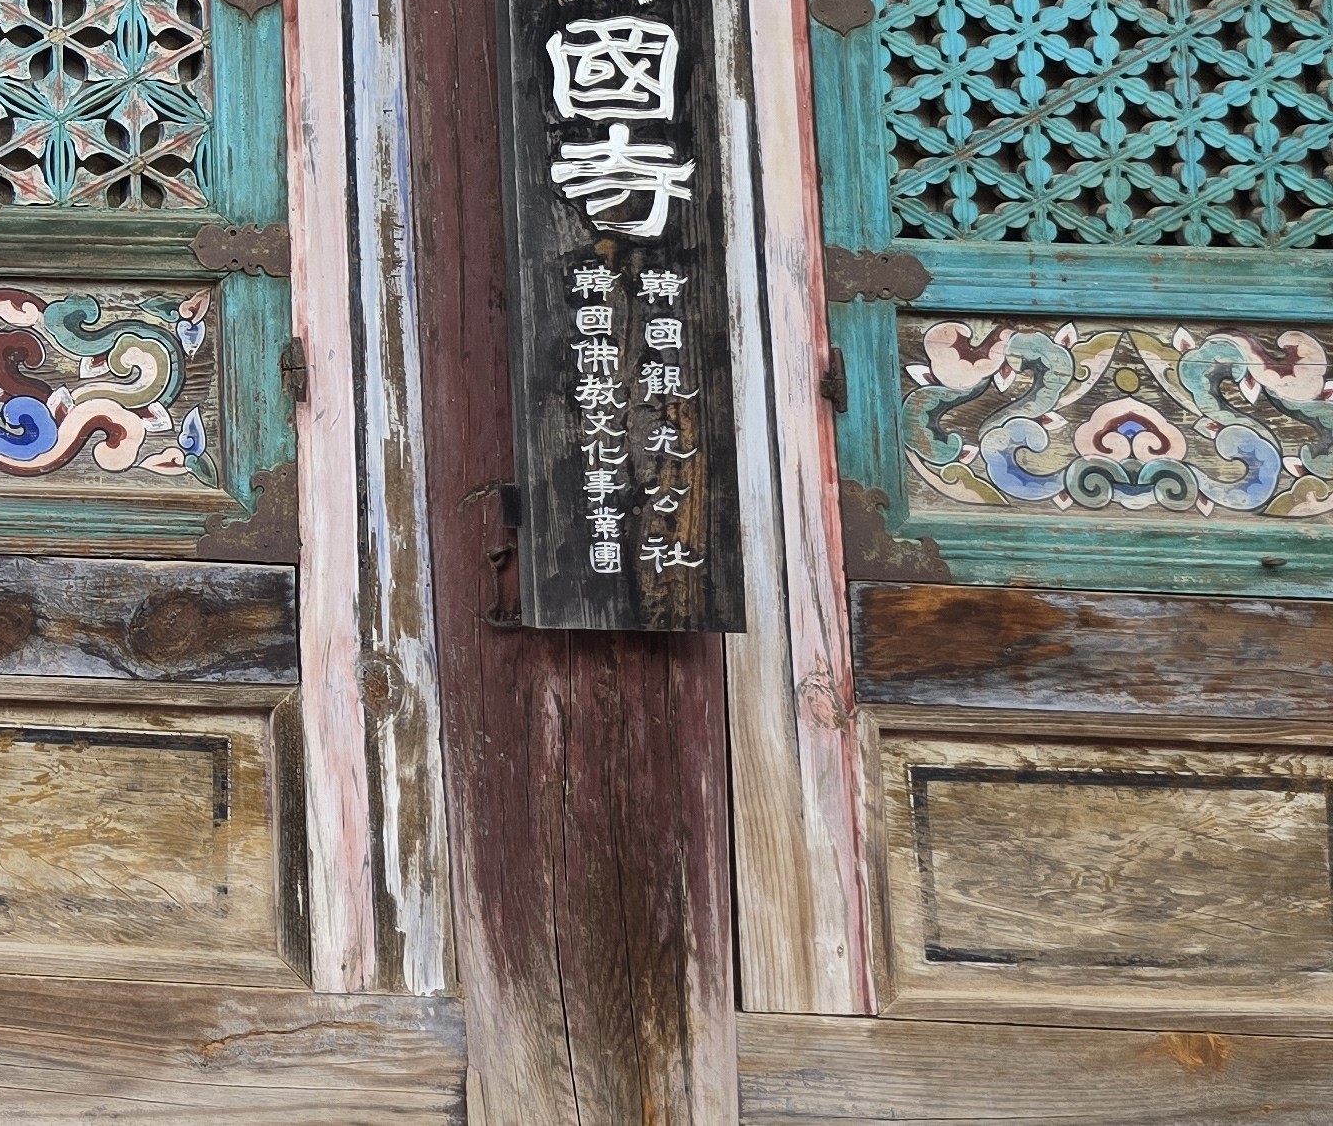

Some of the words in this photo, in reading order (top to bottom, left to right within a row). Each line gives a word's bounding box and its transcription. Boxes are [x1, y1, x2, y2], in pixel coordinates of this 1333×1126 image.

[636, 269, 704, 574] 韓國觀光公社
